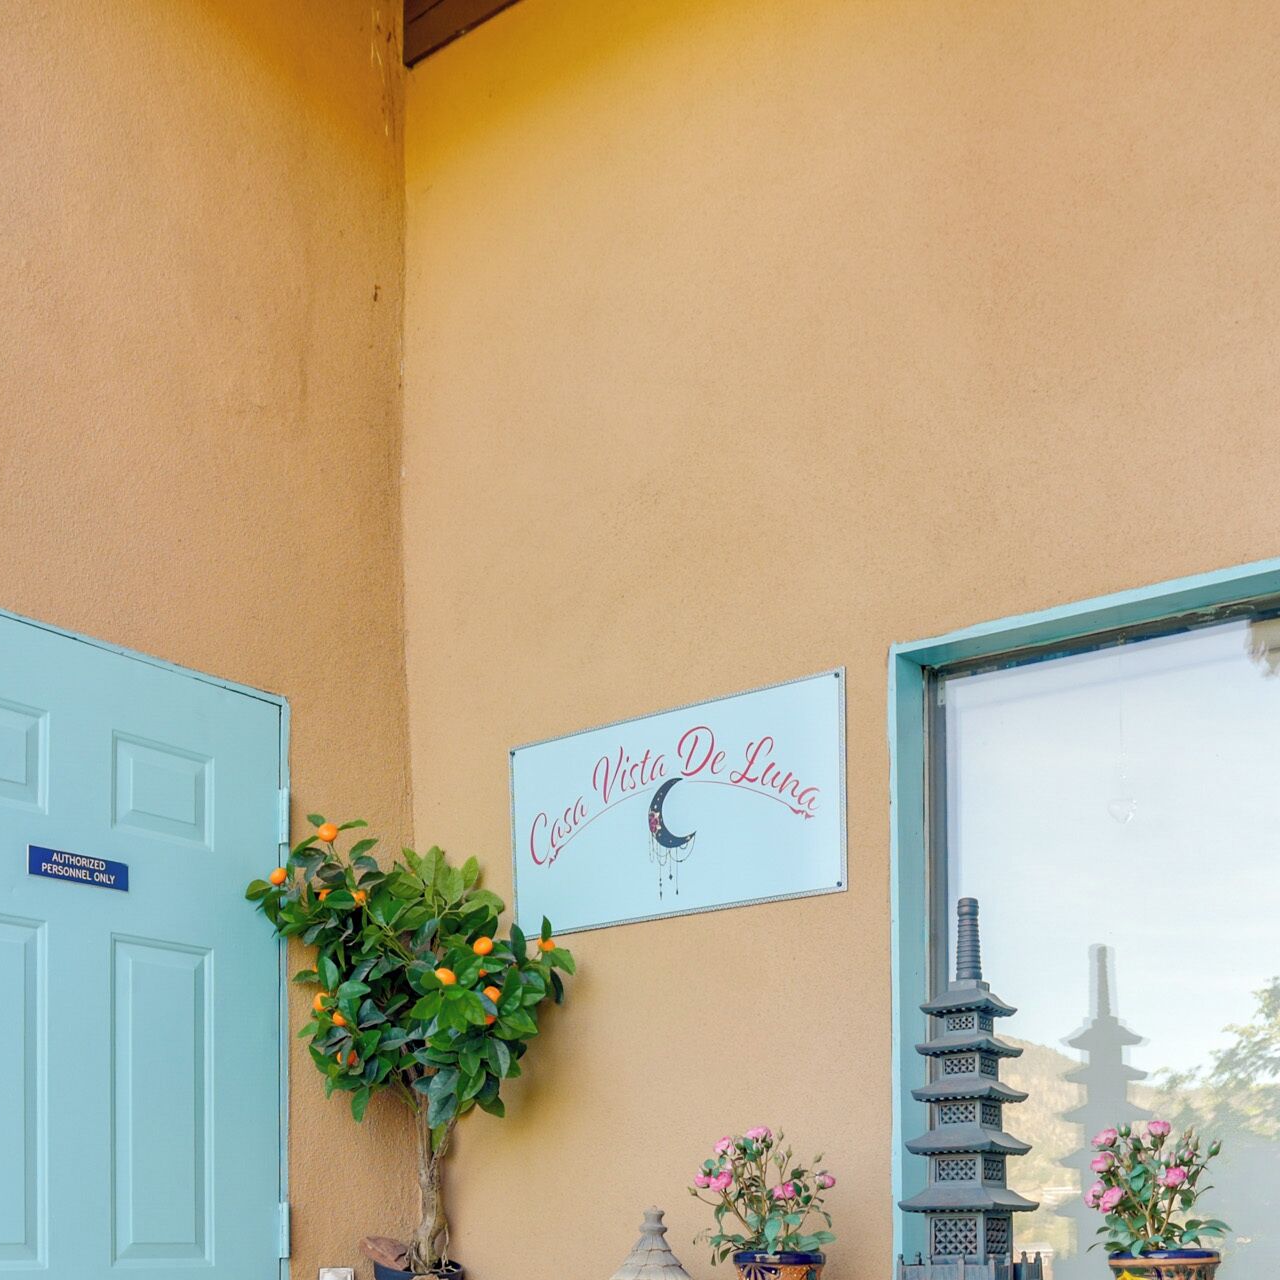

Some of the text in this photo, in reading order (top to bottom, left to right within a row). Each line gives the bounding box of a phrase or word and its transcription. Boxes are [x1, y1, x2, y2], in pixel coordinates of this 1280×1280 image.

[530, 726, 821, 867] Casa Vista De Luna
[52, 852, 106, 871] AUTHORIZED
[41, 862, 116, 885] PERSONNEL ONLY
